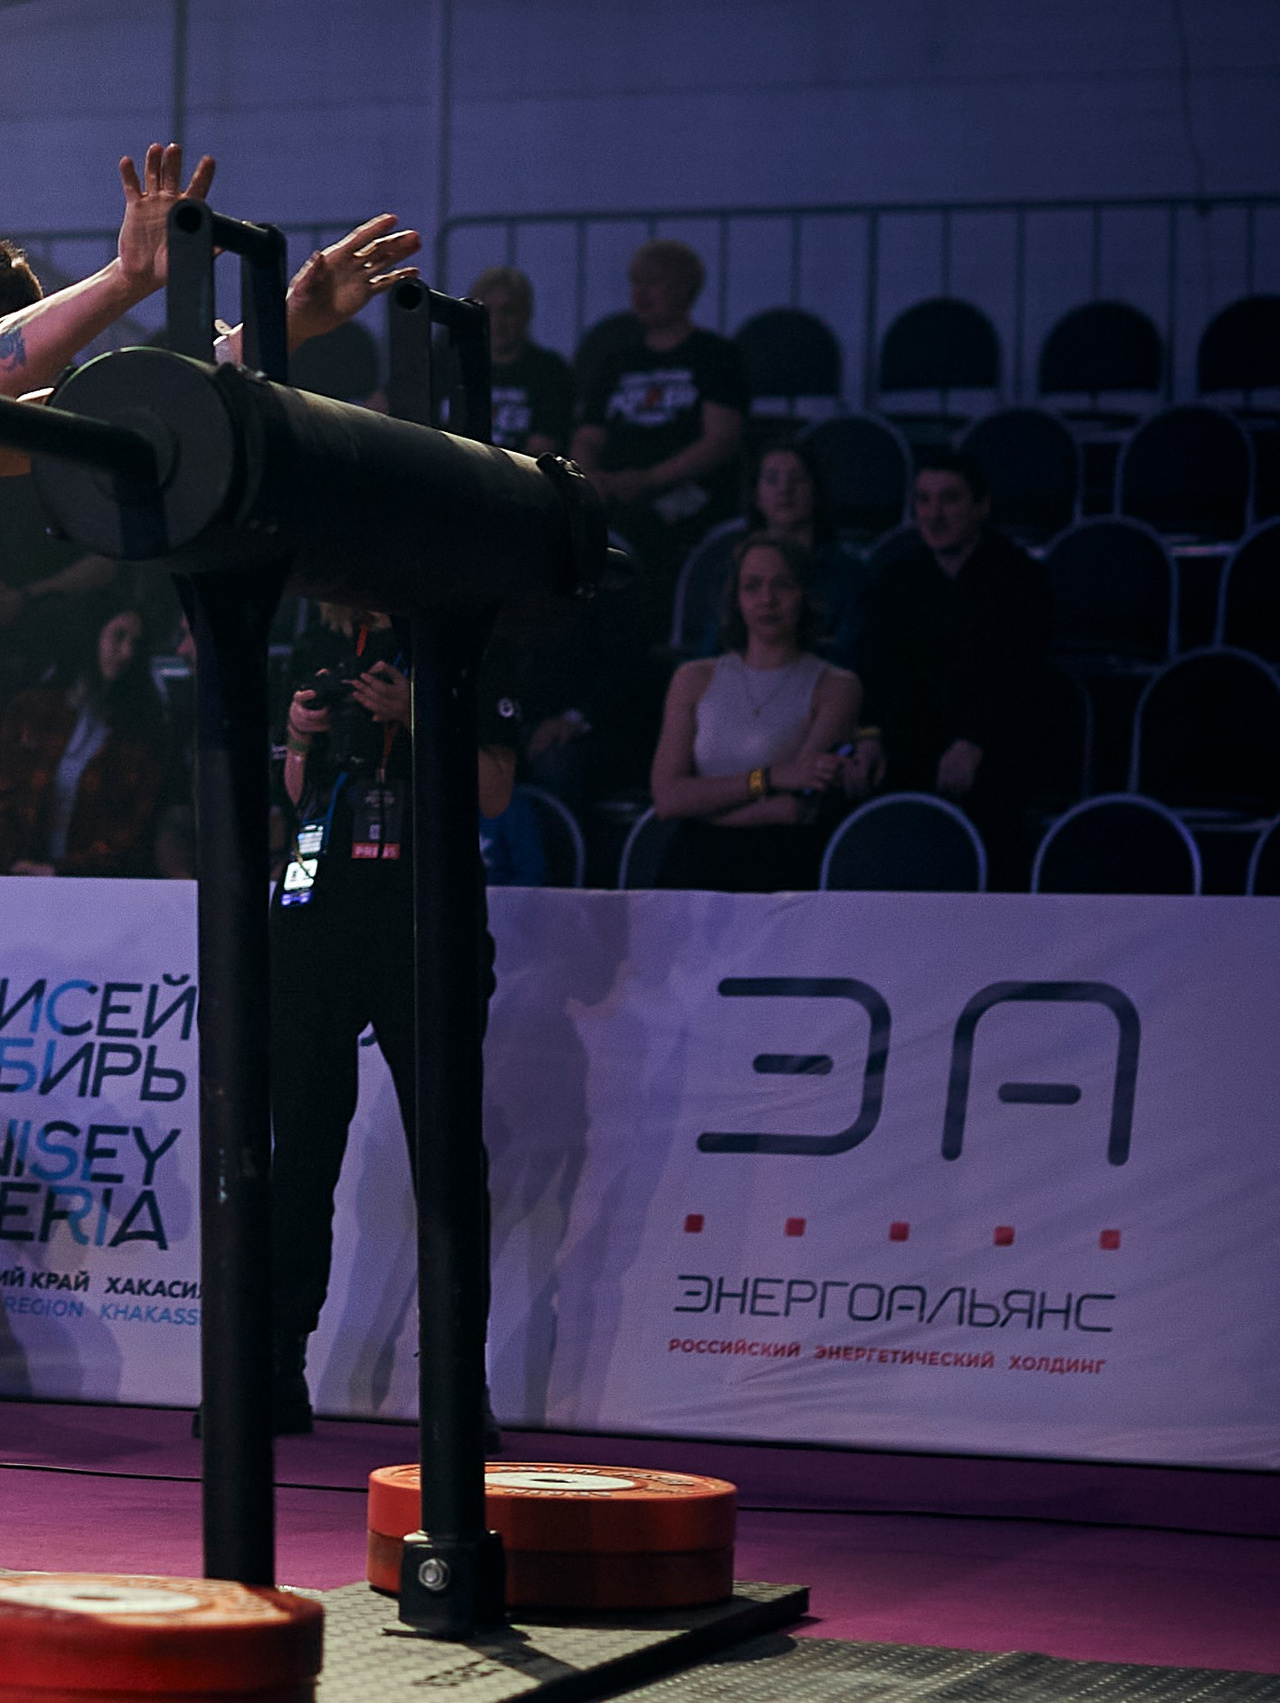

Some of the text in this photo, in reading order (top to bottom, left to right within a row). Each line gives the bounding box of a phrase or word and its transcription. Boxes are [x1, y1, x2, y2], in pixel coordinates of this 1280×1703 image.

[31, 1270, 90, 1293] КРАЙ
[104, 1276, 201, 1300] ХАКАСИ
[4, 1295, 84, 1318] REGION
[99, 1302, 198, 1326] KHAKASS
[673, 1274, 1117, 1334] ЭНЕРГОАЛЬЯНС
[667, 1337, 1108, 1376] РОССИЙСКИЙ ЭНЕРГЕТИЧЕСКИЙ ХОЛДИНГ
